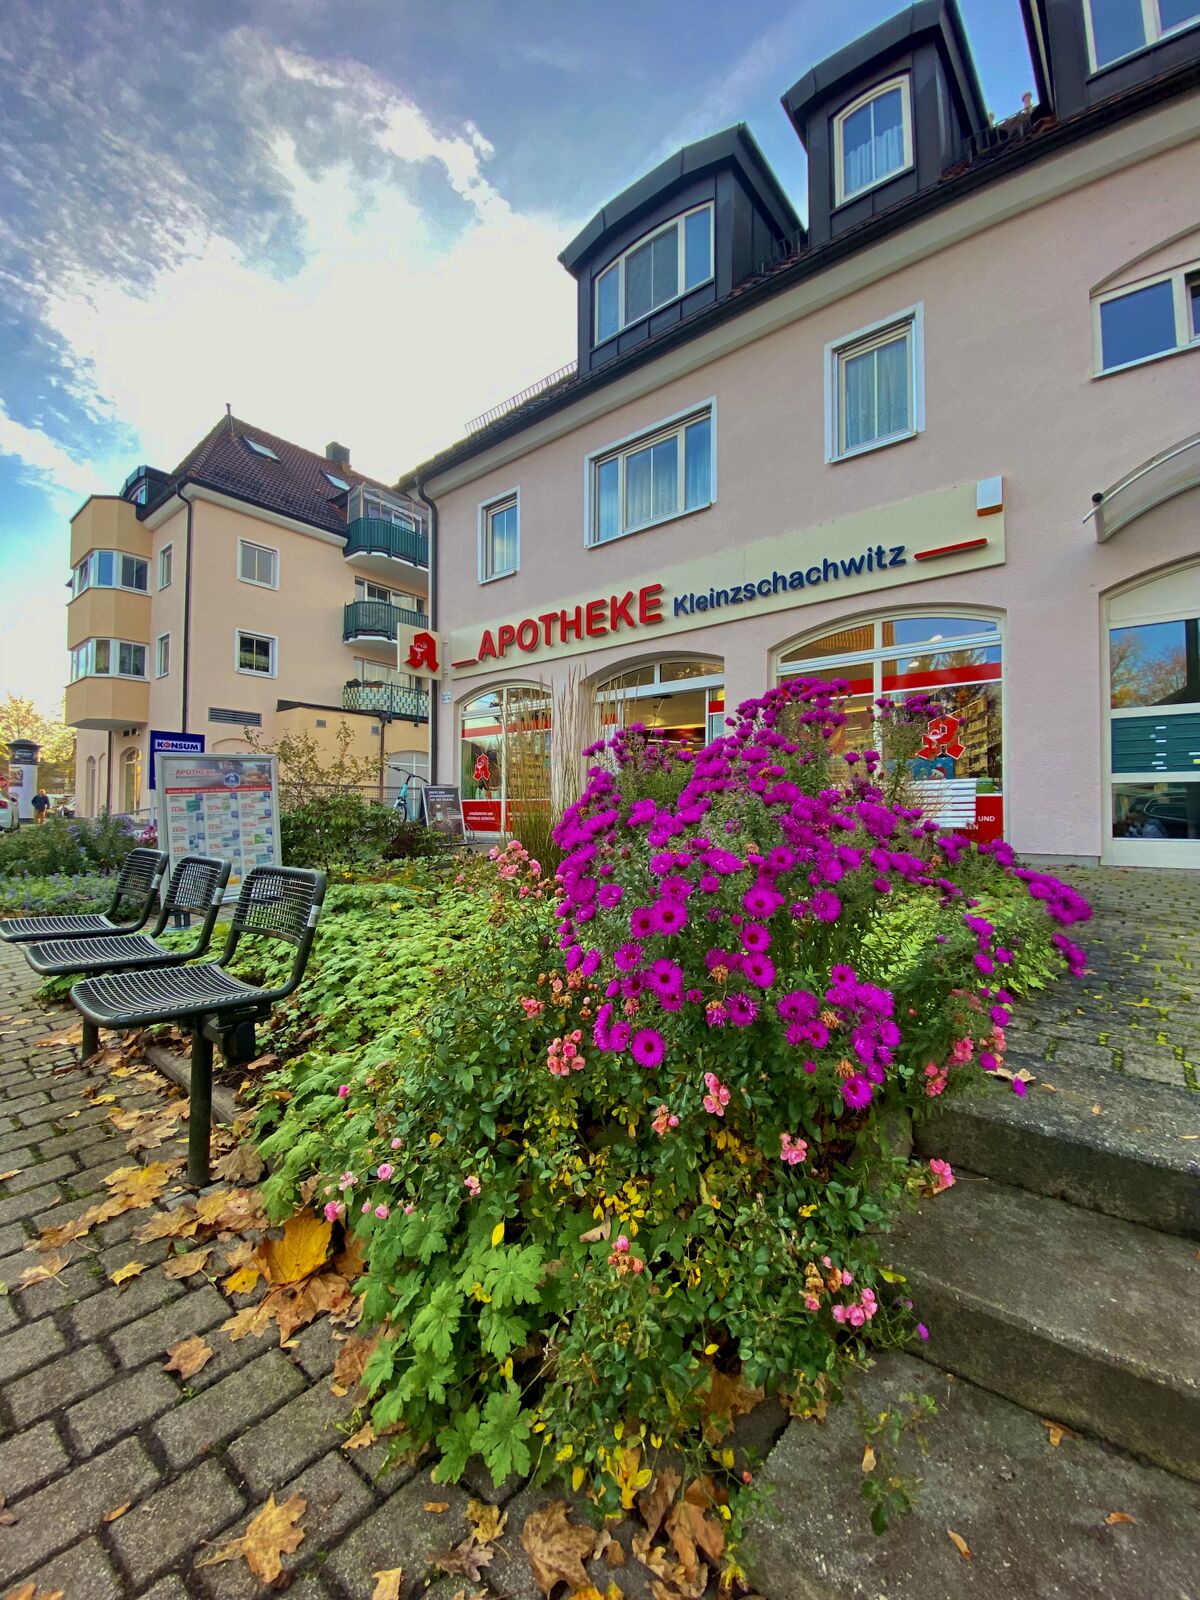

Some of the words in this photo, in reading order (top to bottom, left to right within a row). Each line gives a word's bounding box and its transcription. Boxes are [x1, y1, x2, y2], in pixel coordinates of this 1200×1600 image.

[478, 583, 664, 661] APOTHEKE
[673, 544, 907, 617] Kleinzschachwitz
[156, 740, 199, 751] KONSUM
